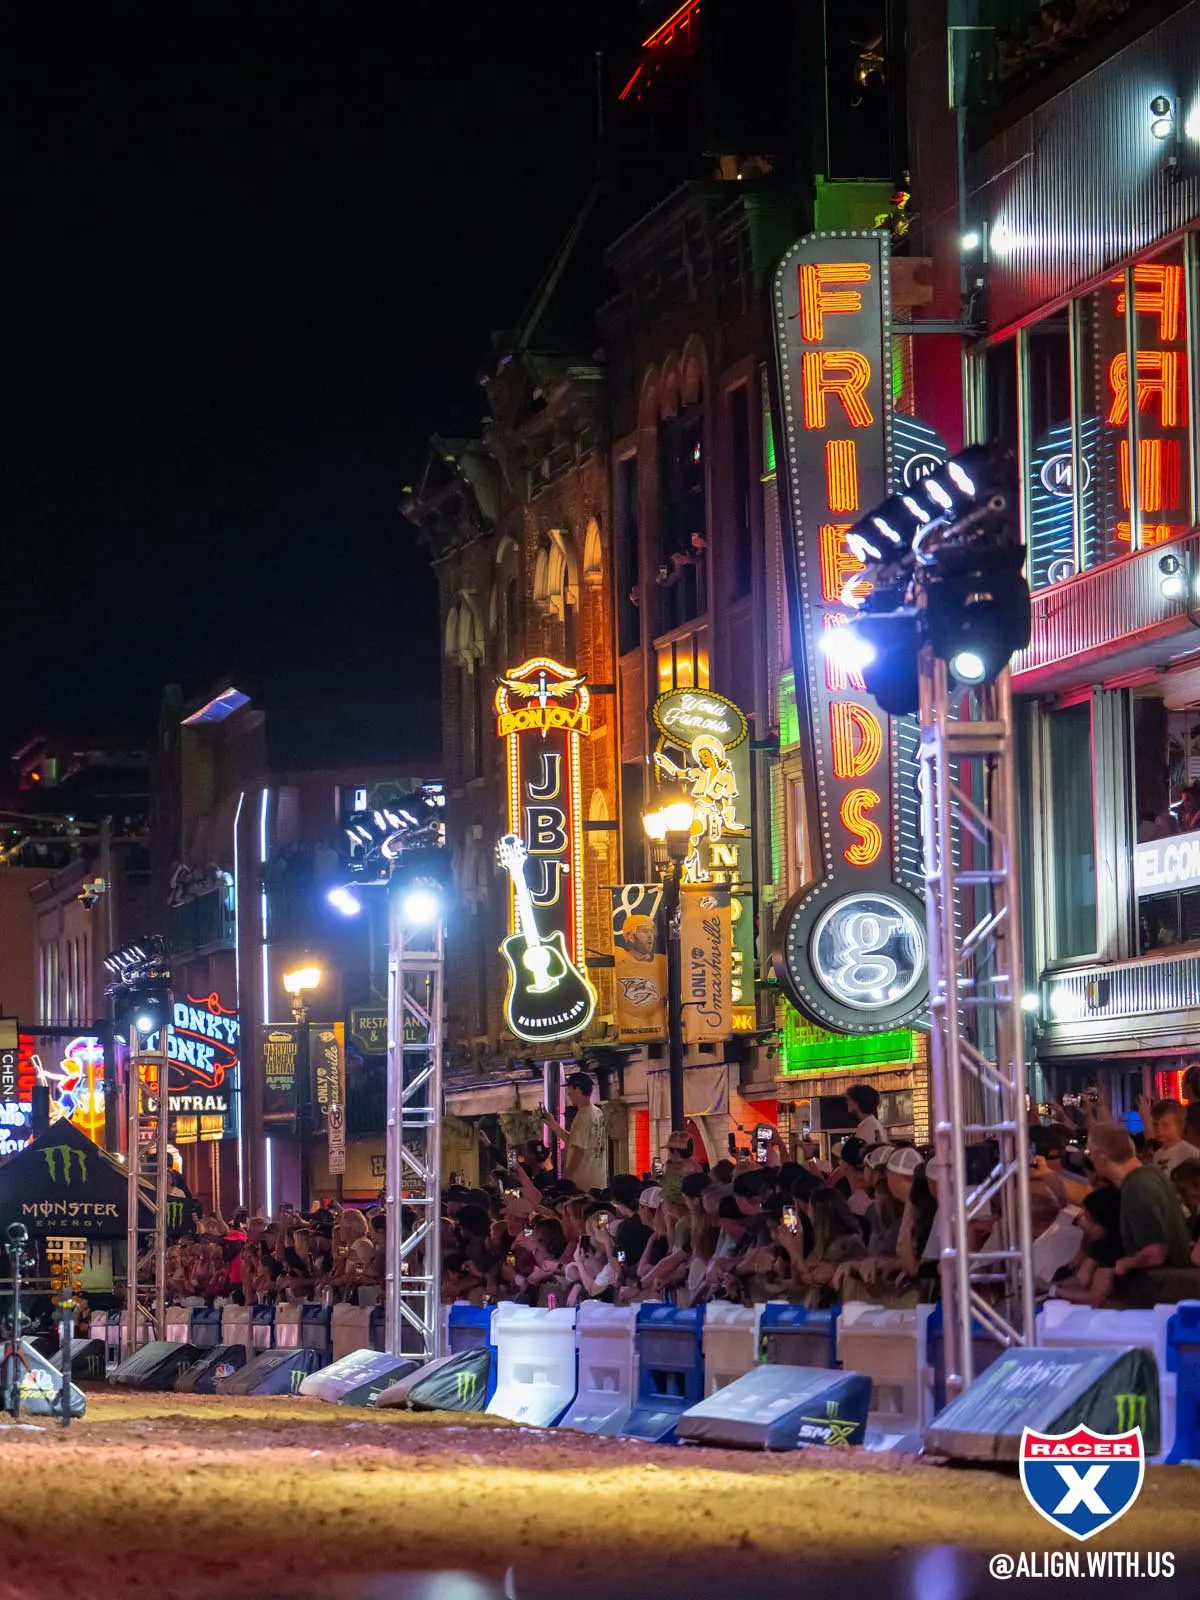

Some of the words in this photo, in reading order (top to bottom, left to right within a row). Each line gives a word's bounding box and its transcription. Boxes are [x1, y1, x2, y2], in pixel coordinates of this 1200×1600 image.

[692, 963, 706, 998] ONLY
[697, 915, 722, 1028] Smashville
[169, 1002, 239, 1045] ONKY
[265, 1076, 295, 1084] APRIL
[317, 1077, 329, 1103] ONLY
[147, 1095, 227, 1112] CNTRAL
[22, 1200, 119, 1217] MONSTER
[35, 1219, 104, 1228] ENERGY
